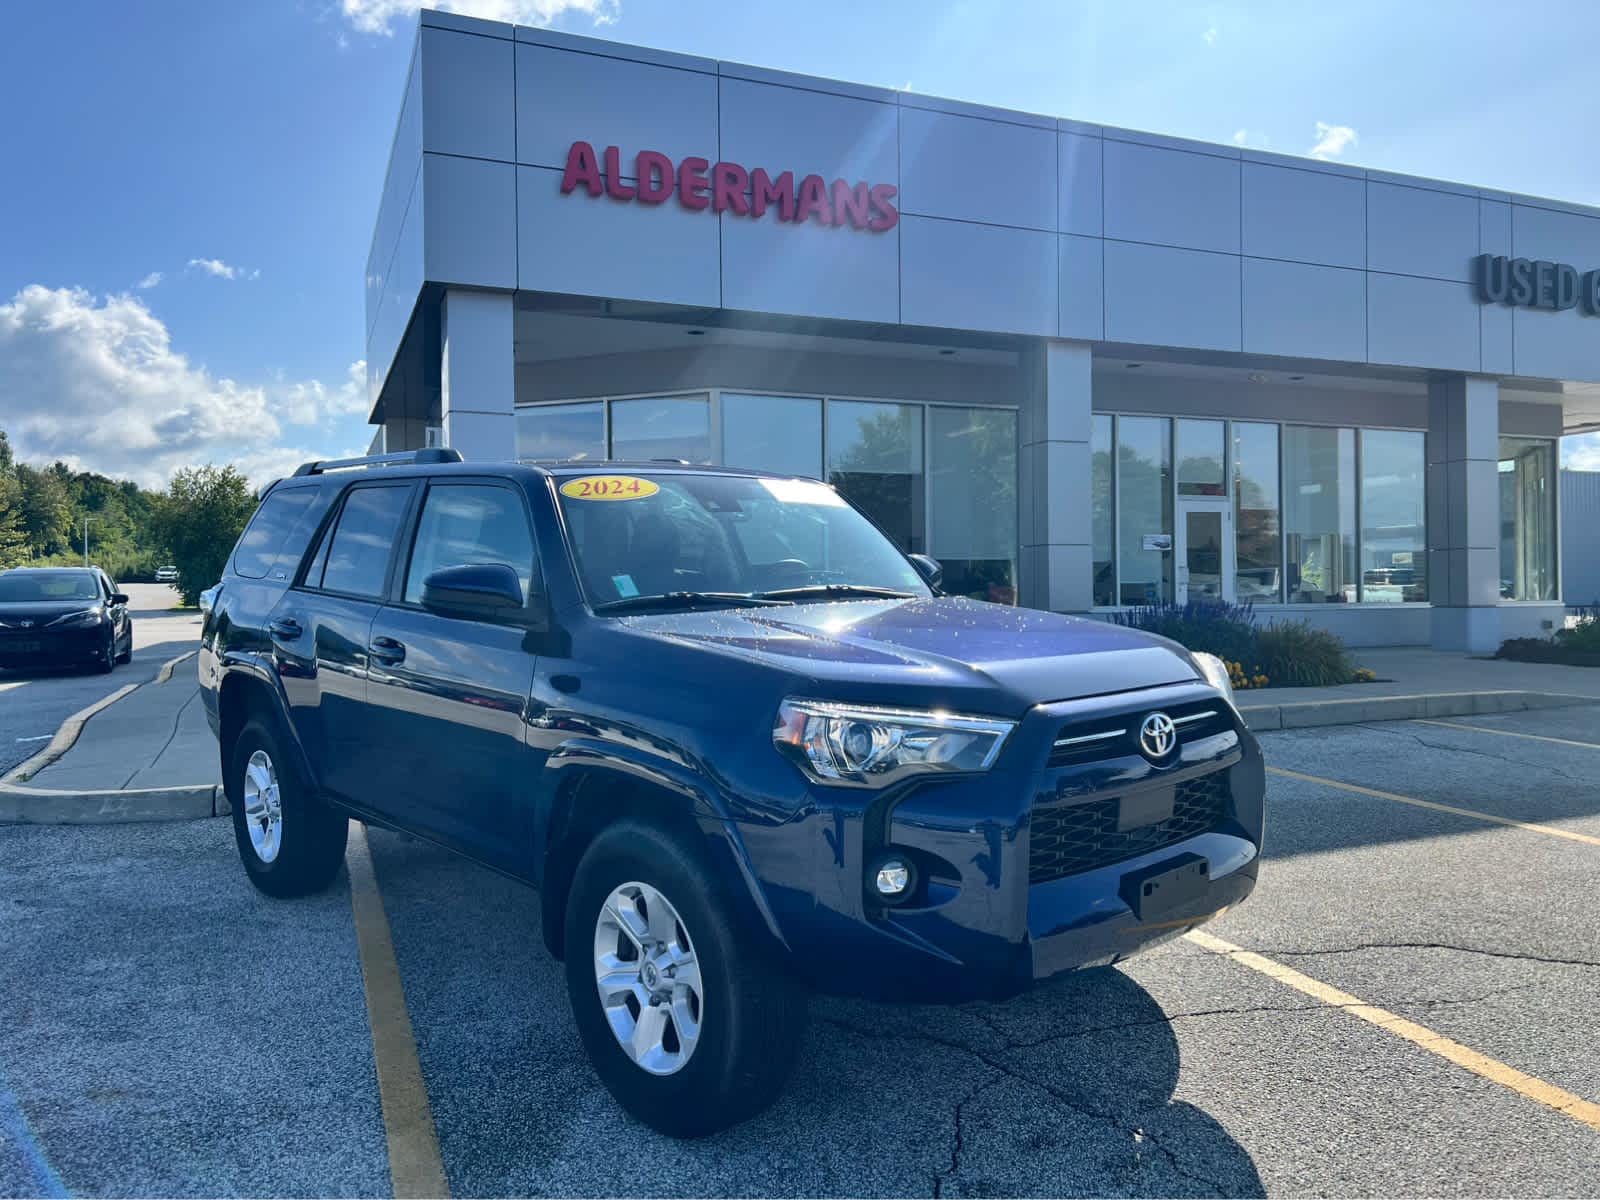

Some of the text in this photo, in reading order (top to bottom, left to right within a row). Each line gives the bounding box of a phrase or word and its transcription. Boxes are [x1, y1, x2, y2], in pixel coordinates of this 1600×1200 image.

[560, 141, 898, 232] ALDERMANS
[1474, 254, 1578, 312] USED
[579, 479, 640, 496] 2024
